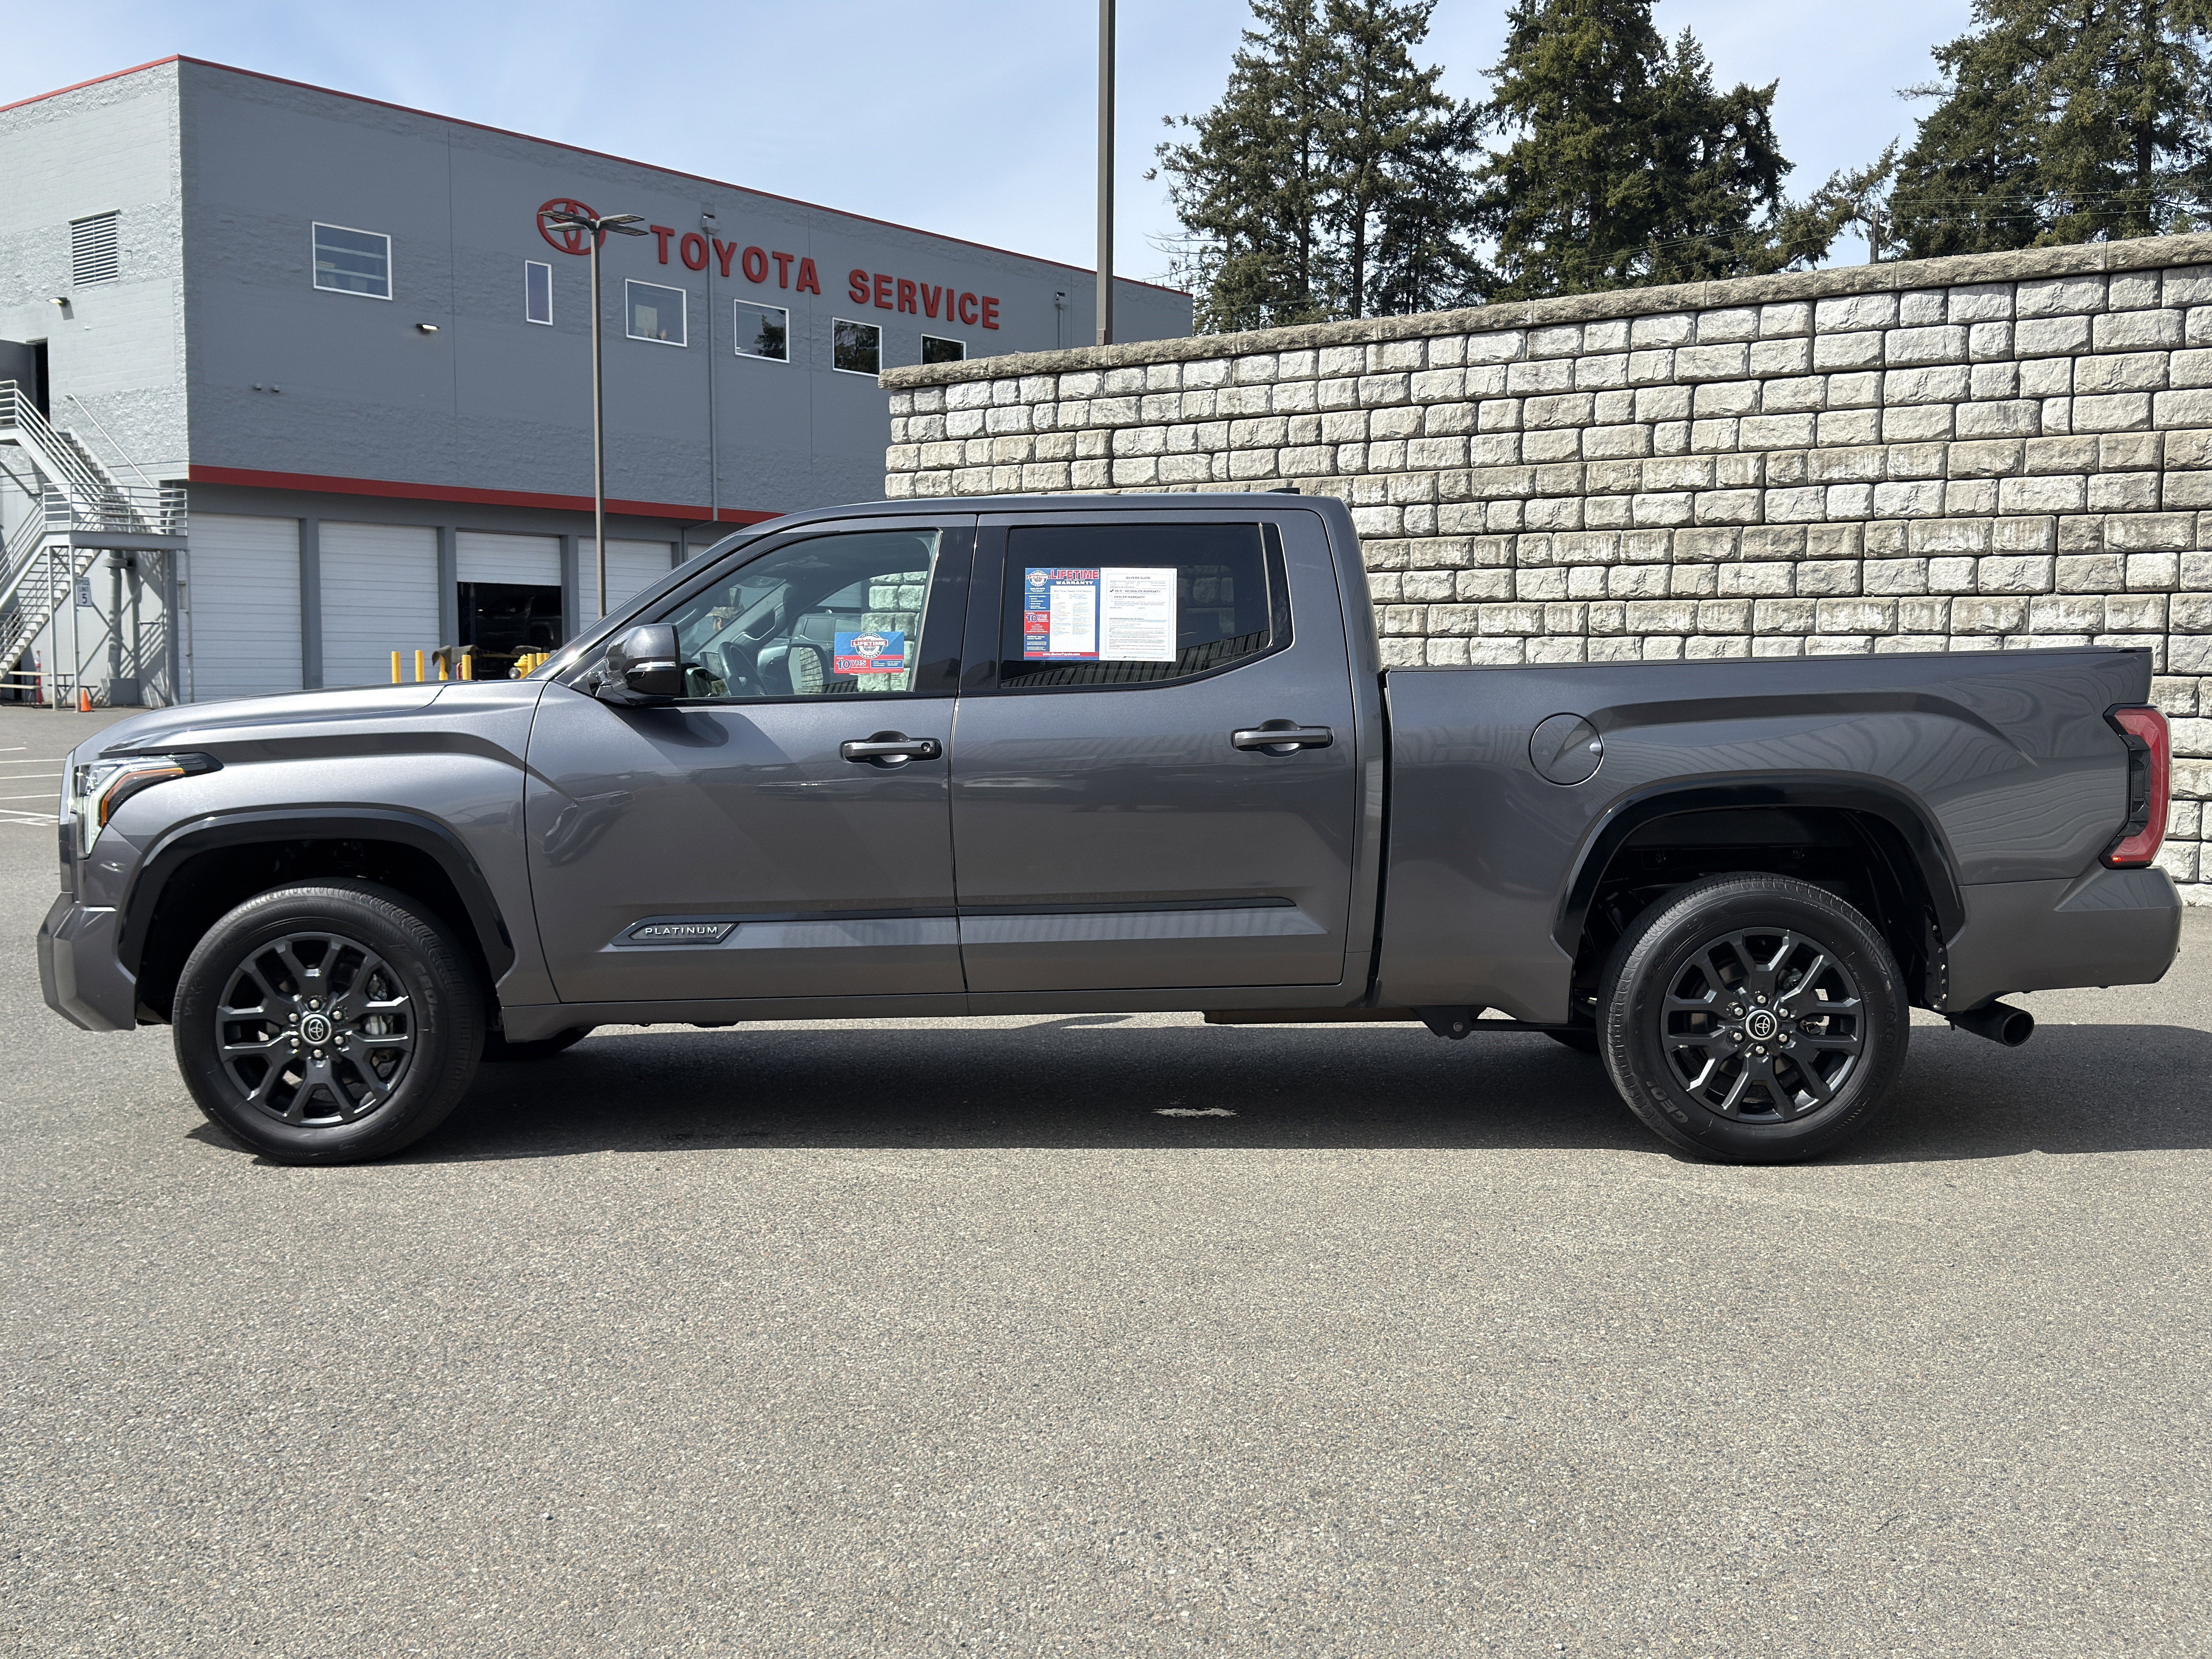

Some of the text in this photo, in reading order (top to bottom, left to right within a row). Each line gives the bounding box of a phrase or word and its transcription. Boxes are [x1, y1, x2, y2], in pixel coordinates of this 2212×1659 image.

[650, 224, 1000, 329] TOYOTA SERVICE
[1051, 570, 1099, 579] LIFETIME
[82, 593, 88, 604] 5
[1026, 614, 1038, 622] 10
[858, 650, 880, 658] WARRANTY
[836, 659, 851, 670] 10
[645, 926, 717, 935] PLATINUM
